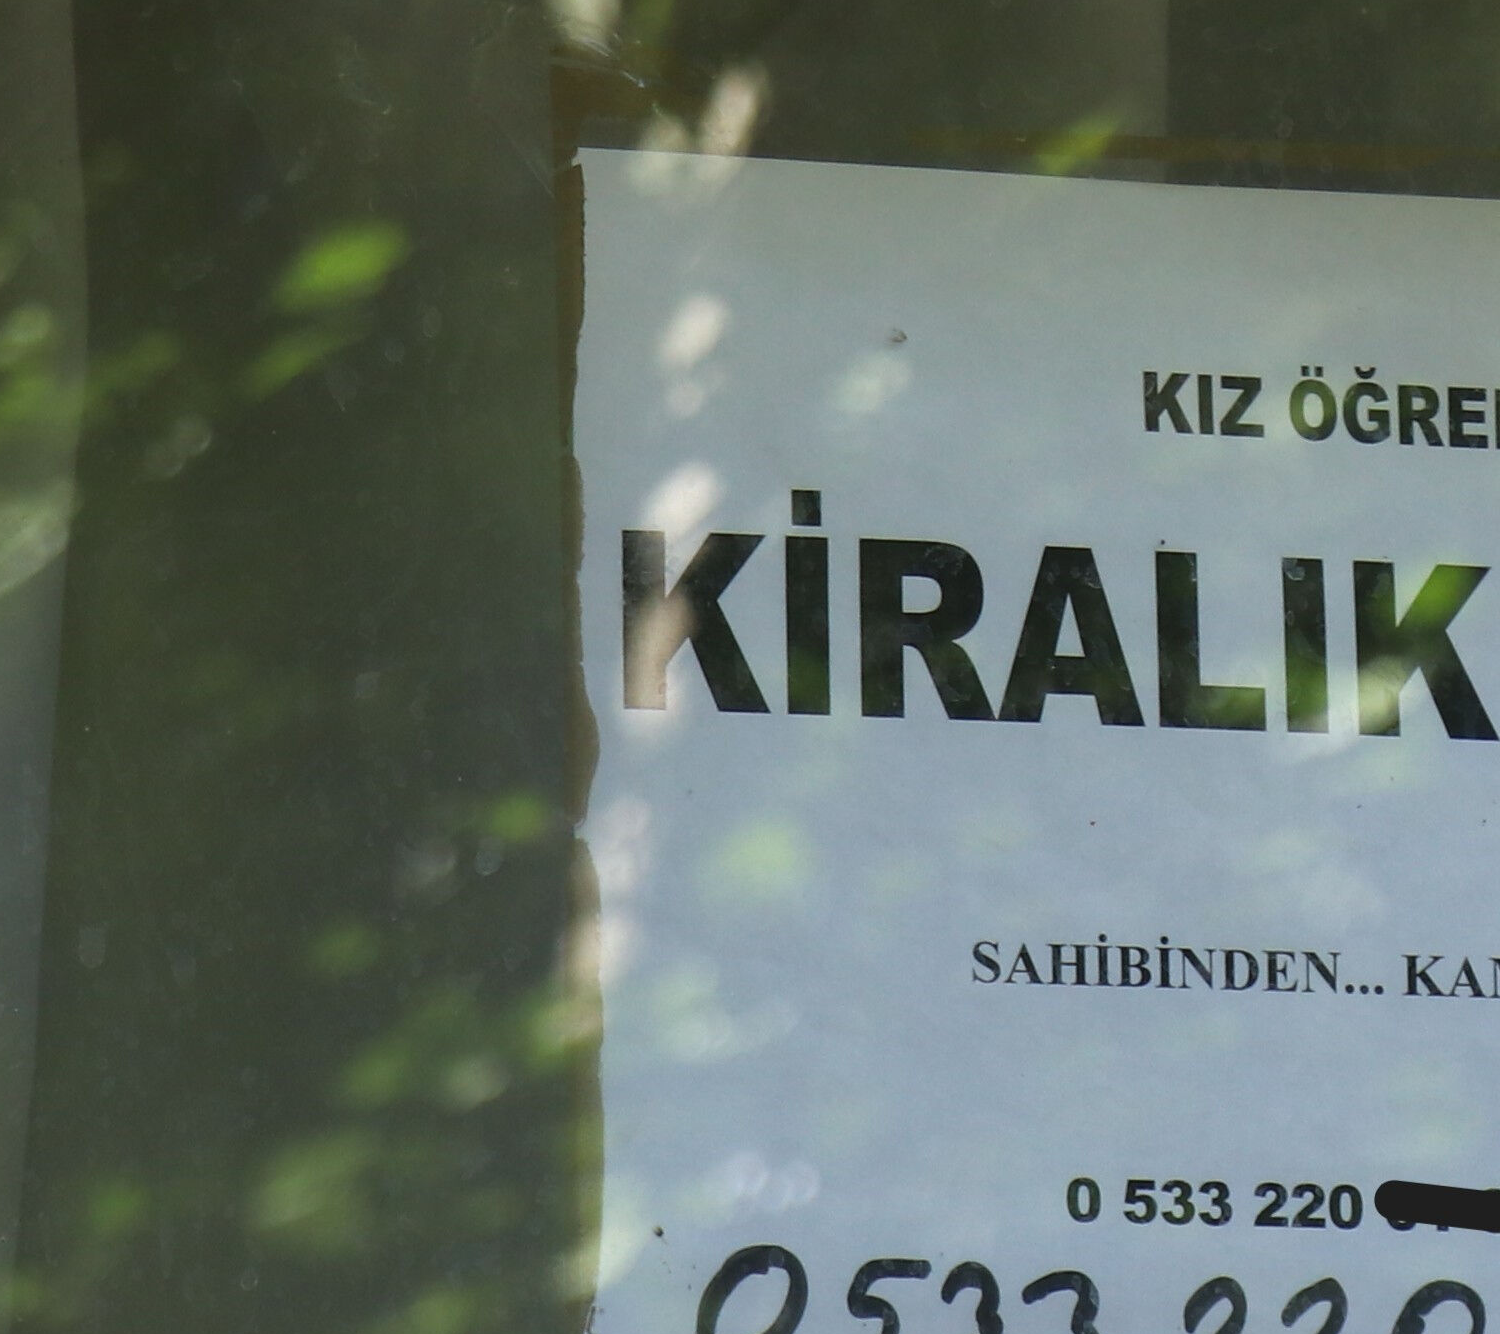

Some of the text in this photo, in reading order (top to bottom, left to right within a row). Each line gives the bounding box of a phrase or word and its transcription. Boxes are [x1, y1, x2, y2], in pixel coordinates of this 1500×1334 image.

[1142, 370, 1265, 438] KIZ
[621, 488, 1500, 741] KİRALIK
[971, 933, 1385, 996] SAHİBİNDEN...
[1066, 1177, 1102, 1223] 0
[1123, 1178, 1233, 1227] 533
[1253, 1181, 1364, 1230] 220
